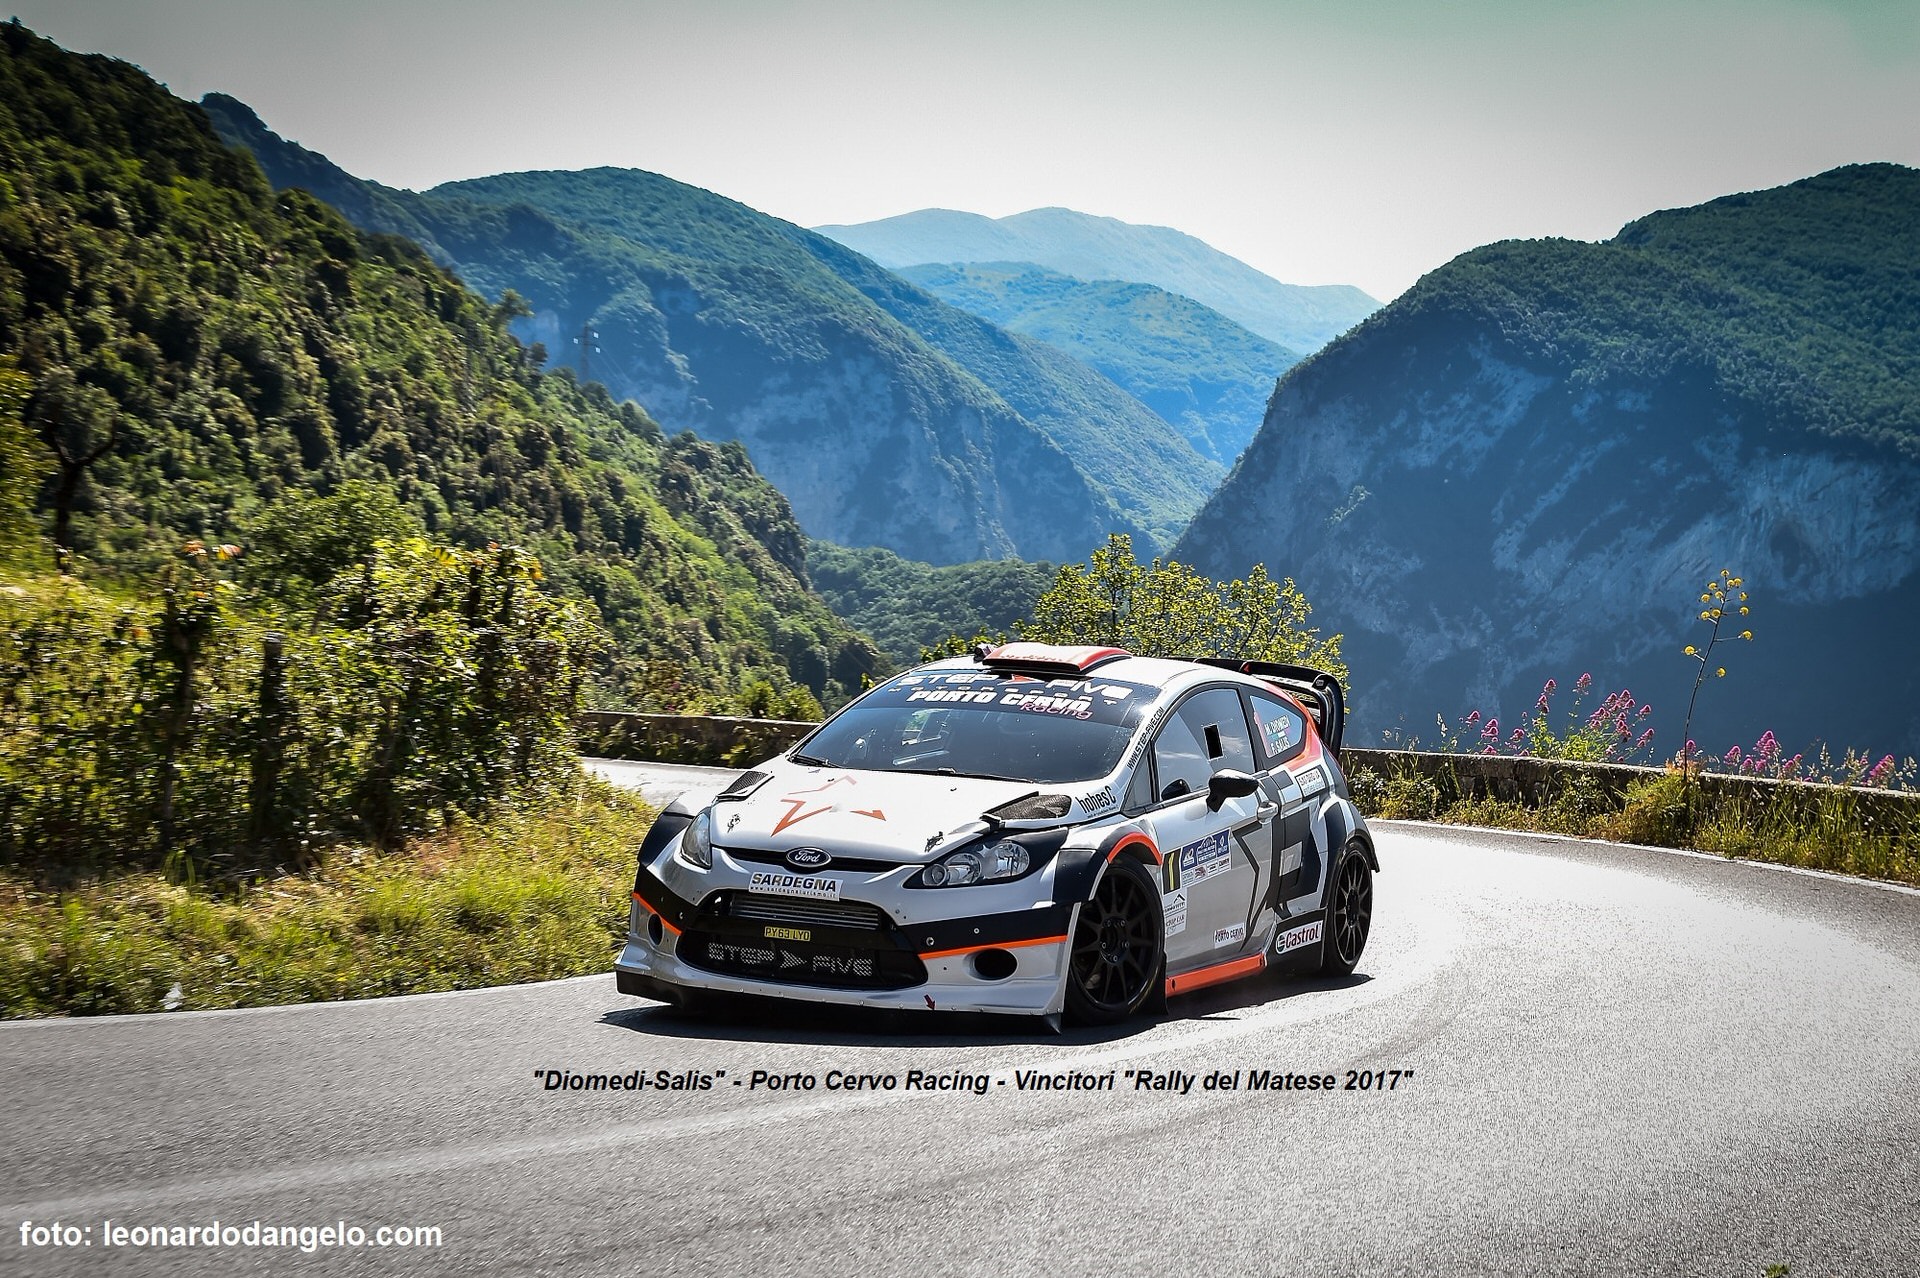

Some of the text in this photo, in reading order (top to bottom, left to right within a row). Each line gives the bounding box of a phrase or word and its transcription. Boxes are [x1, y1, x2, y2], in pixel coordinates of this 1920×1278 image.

[896, 673, 1134, 699] STEP FIVE
[906, 690, 1093, 713] PORTO CERVO
[1020, 702, 1093, 720] Racing
[794, 851, 820, 863] Ford
[752, 873, 836, 892] SARDEGNA
[1168, 852, 1176, 891] 1
[765, 927, 791, 939] PY63
[1285, 924, 1320, 948] Castrol
[708, 943, 873, 976] STEP FIVE
